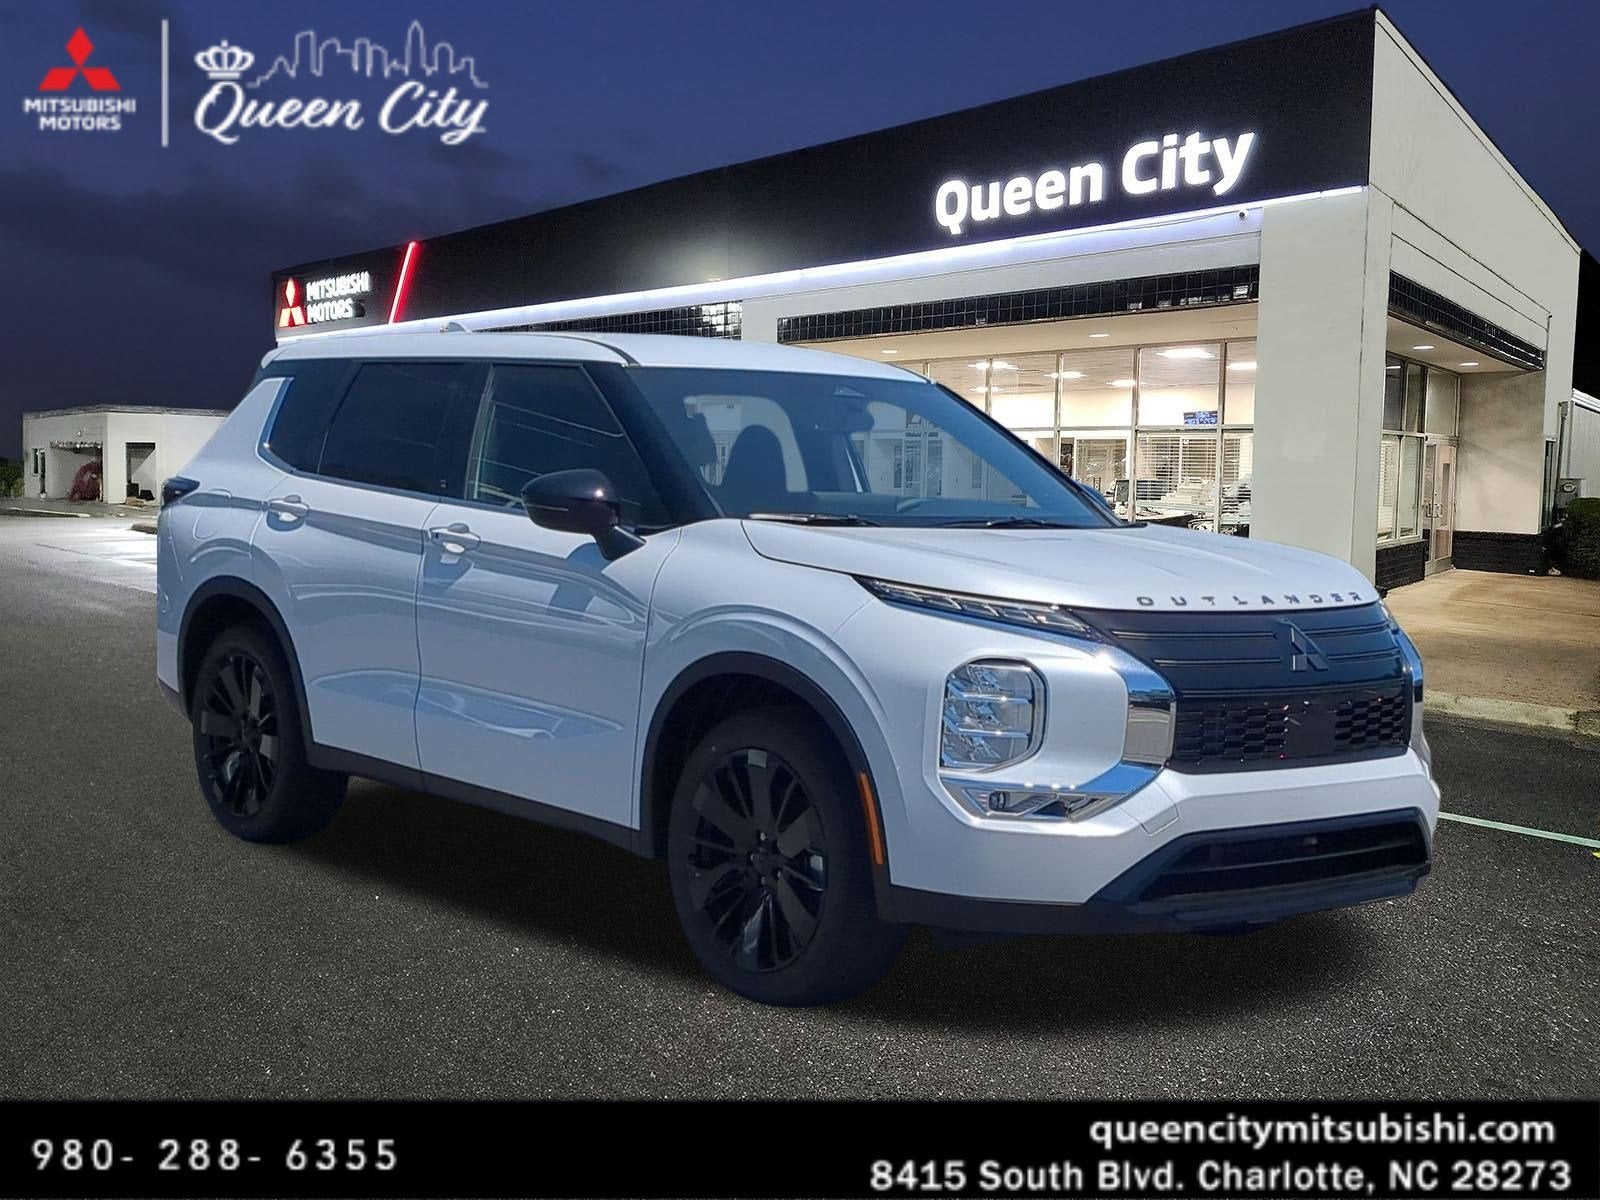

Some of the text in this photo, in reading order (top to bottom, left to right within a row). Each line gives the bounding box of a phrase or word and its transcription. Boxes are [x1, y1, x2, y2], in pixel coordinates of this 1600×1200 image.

[935, 132, 1255, 235] Queen City
[306, 271, 371, 301] MITSUBISHI
[307, 298, 354, 323] MOTORS
[1136, 592, 1363, 607] OUTLANDER
